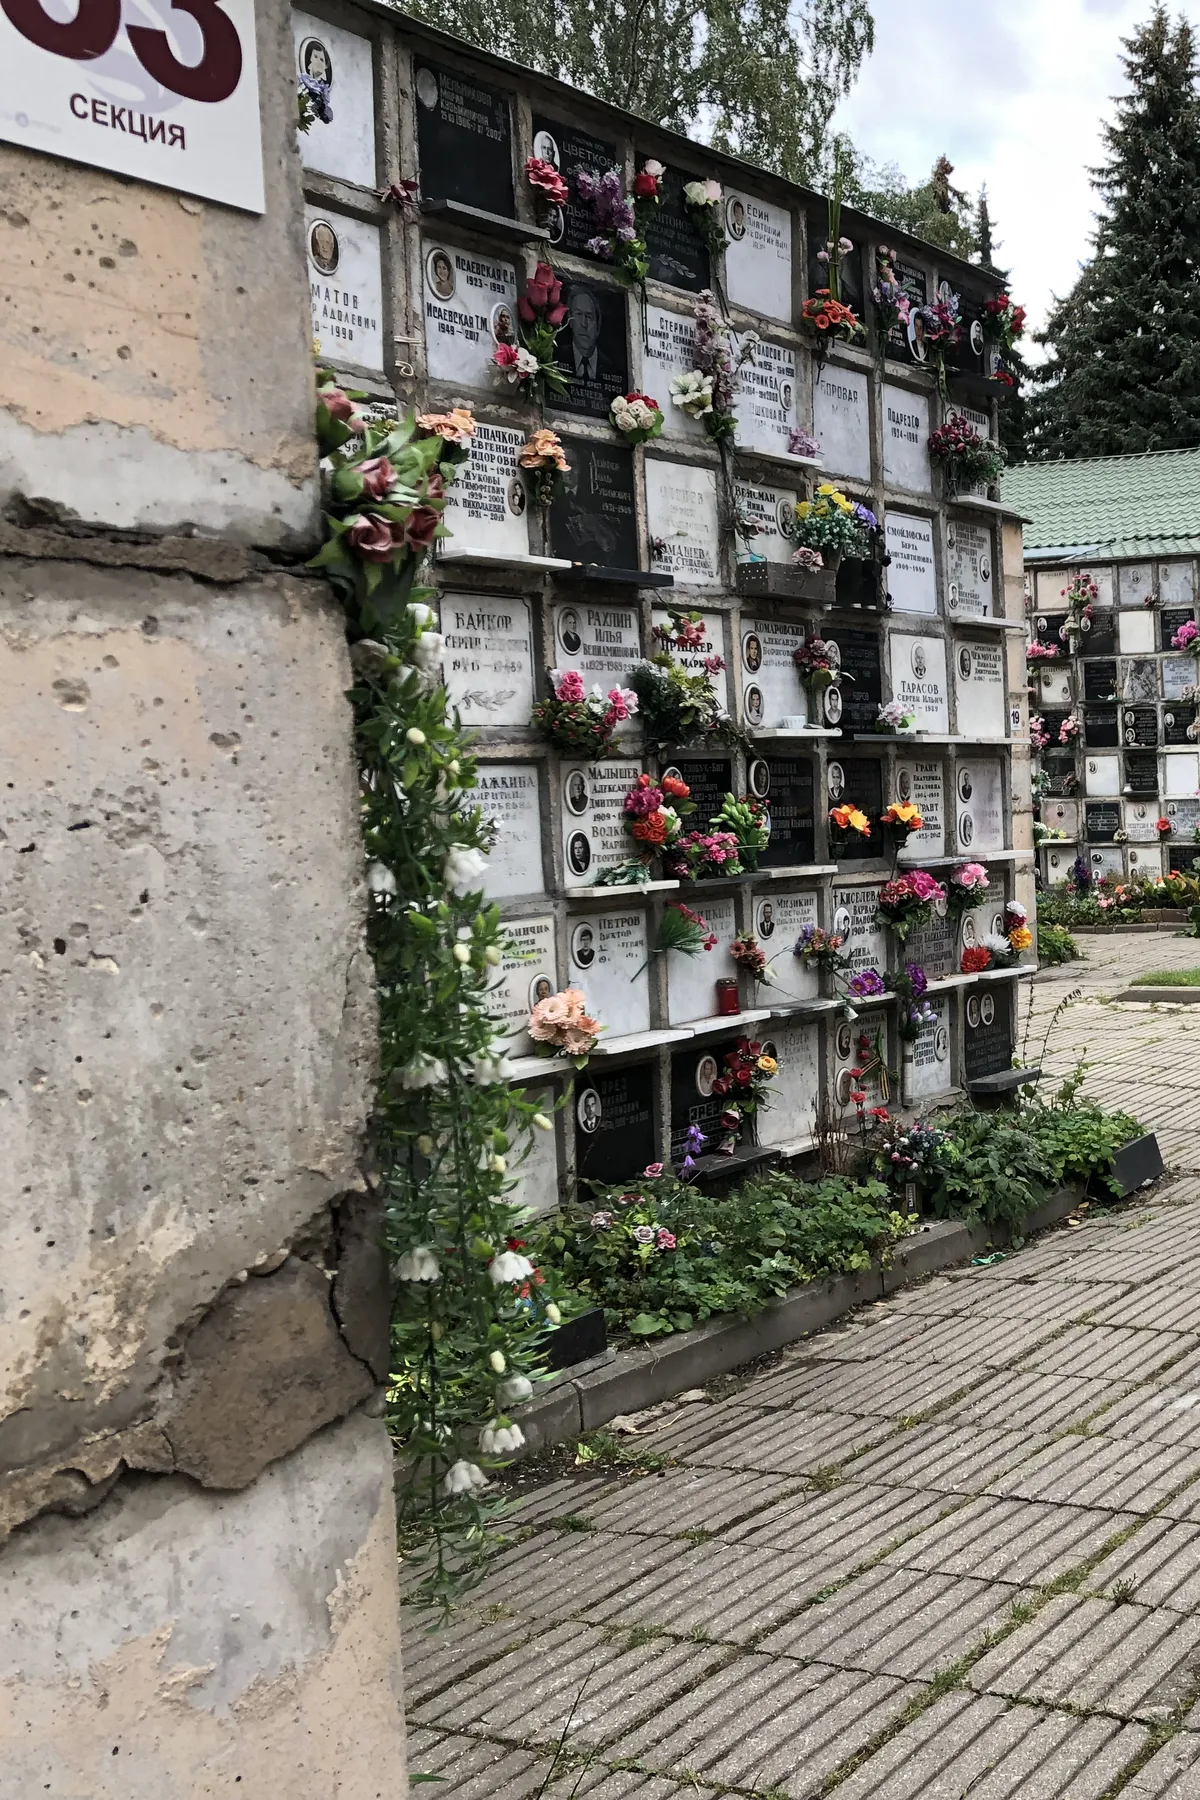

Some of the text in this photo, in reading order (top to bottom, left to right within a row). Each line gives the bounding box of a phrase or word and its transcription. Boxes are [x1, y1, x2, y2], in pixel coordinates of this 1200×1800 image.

[69, 93, 187, 150] СЕКЦИЯ
[562, 141, 614, 168] ЦВЕТКОВ
[455, 255, 502, 280] ИСАЕВСКАЯ
[311, 283, 359, 310] МАТОВ
[426, 301, 474, 329] ИСАЕВСКАЯ
[475, 426, 526, 447] ЛПАЧКОВА
[470, 439, 516, 456] ЕВГЕНИЯ
[587, 609, 632, 629] РАХЛИН
[595, 628, 622, 644] ИЛЬЯ
[900, 680, 939, 695] ТАРАСОВ
[896, 694, 944, 705] СЕРГЕЙ ИЛЬИЧ
[1010, 710, 1020, 725] 19
[587, 766, 639, 780] МАЛЫШЕВ
[915, 762, 938, 772] ГРАНТ
[598, 916, 641, 931] ПЕТРОВ
